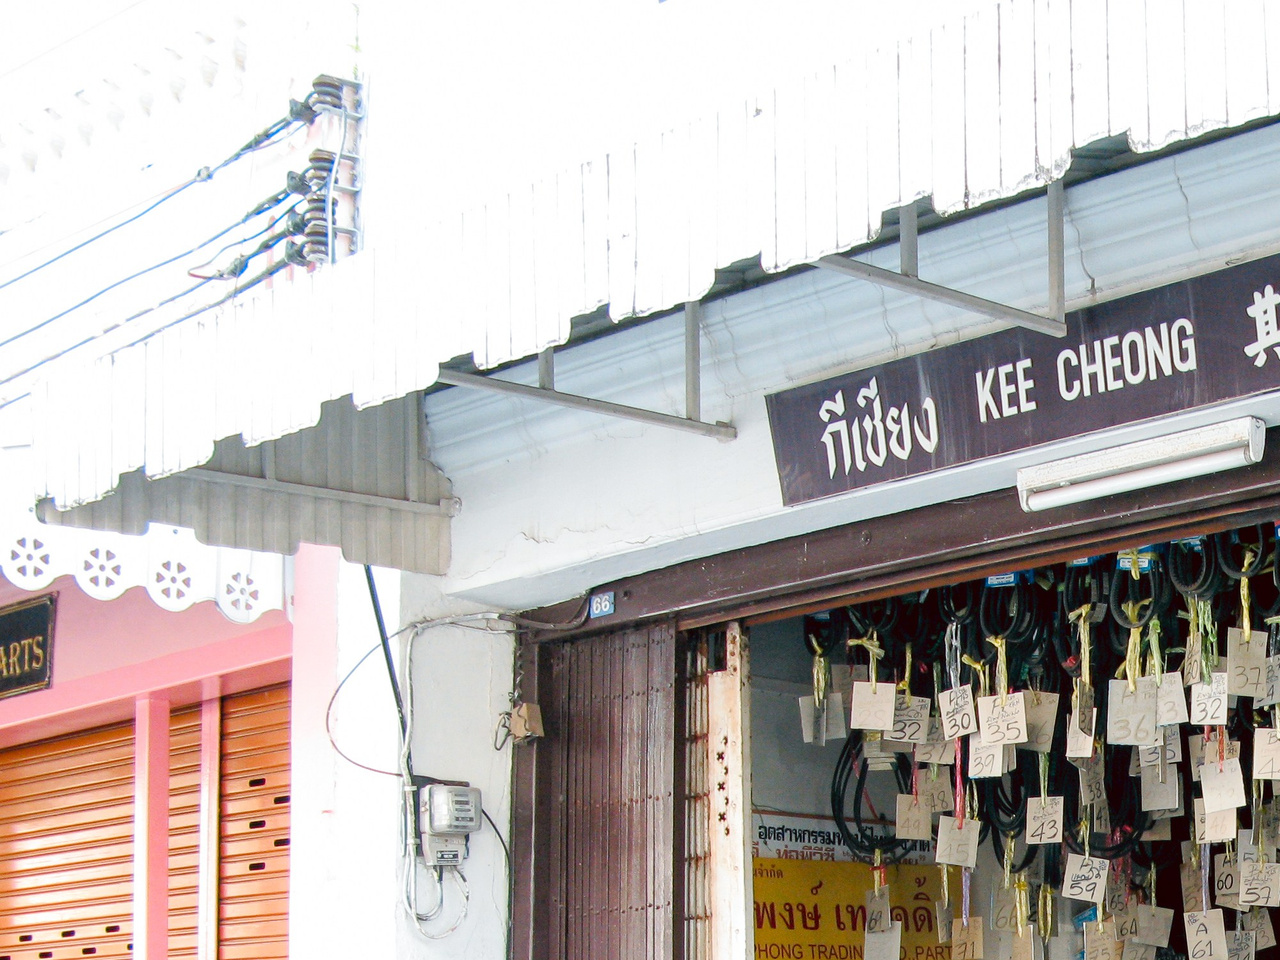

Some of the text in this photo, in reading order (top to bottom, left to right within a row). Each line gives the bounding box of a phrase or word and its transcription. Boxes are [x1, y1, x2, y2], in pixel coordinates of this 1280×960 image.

[976, 318, 1197, 422] KEE CHEONG
[819, 376, 938, 479] กีเชียง
[592, 594, 610, 614] 66
[1235, 665, 1261, 689] 37
[1197, 698, 1222, 722] 32
[889, 721, 921, 740] 32
[947, 712, 970, 738] 30
[988, 720, 1022, 744] 35
[1113, 715, 1148, 740] 36
[974, 754, 995, 776] 39
[1030, 820, 1059, 842] 43
[1069, 882, 1097, 900] 59
[1217, 873, 1234, 890] 60
[1242, 886, 1271, 905] 57
[1120, 919, 1138, 935] 64
[753, 943, 804, 960] HONG
[808, 944, 864, 960] TRADIN
[1192, 940, 1214, 959] 61
